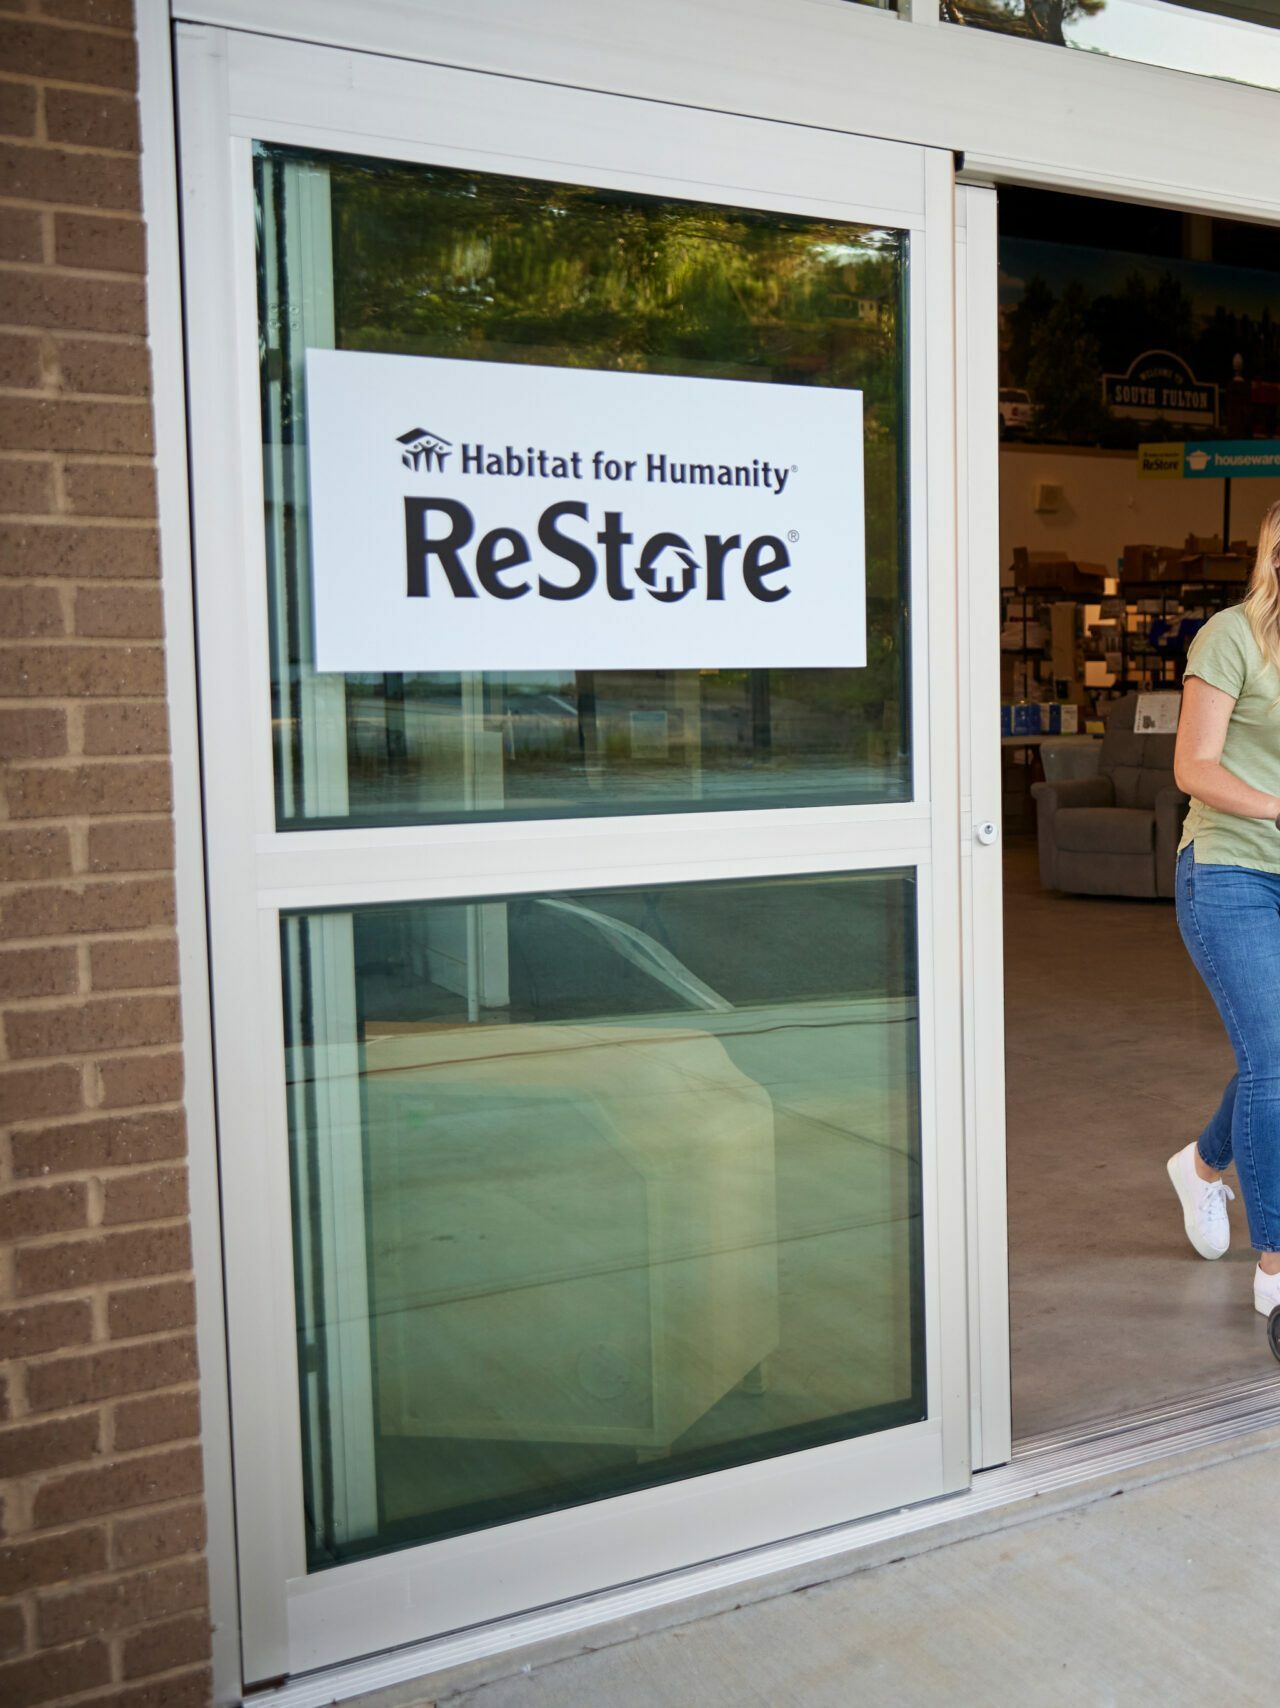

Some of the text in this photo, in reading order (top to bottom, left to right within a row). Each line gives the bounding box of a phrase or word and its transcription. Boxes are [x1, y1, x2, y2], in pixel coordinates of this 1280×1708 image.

[1115, 384, 1208, 408] SOUTH FULTON
[461, 443, 582, 480] Habitat
[592, 450, 637, 482] for
